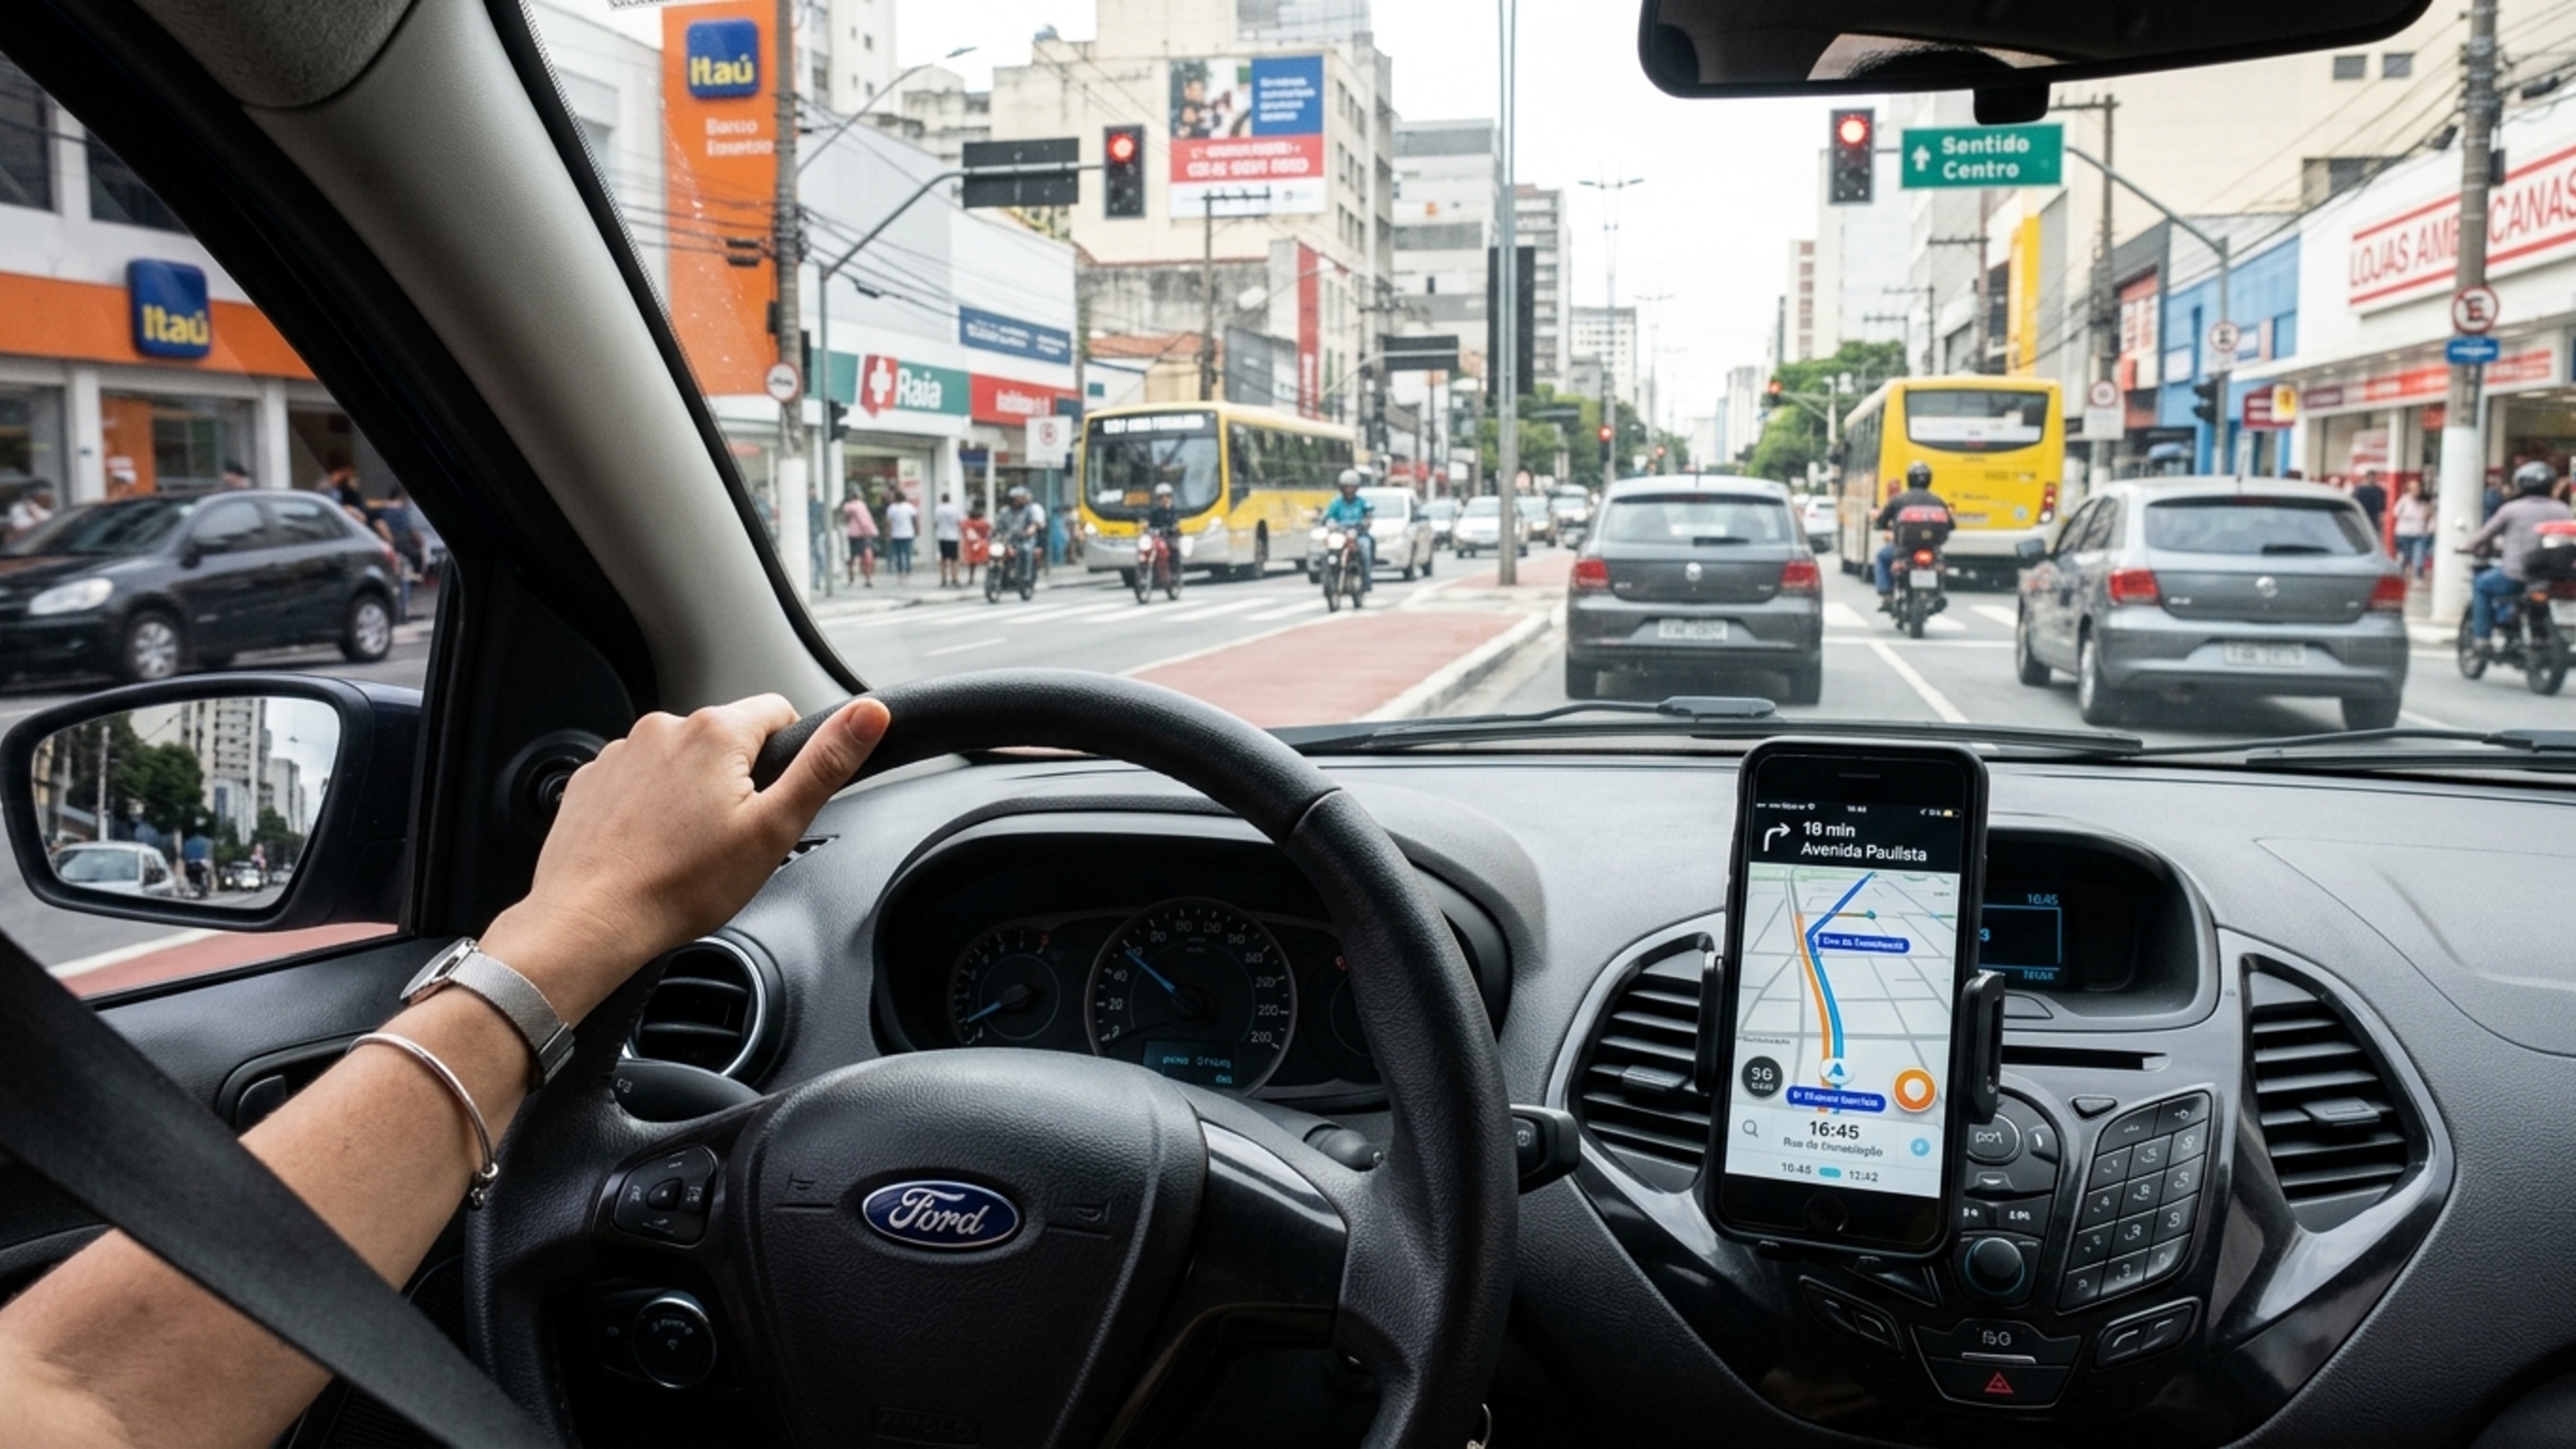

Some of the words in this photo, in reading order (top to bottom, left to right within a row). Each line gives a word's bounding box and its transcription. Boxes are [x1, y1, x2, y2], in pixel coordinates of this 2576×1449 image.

[691, 54, 754, 86] Itaú
[1942, 134, 2030, 155] Sentido
[1942, 161, 2020, 179] Centro
[2350, 232, 2409, 287] LOJAS
[2415, 167, 2576, 268] AMECANAS
[142, 303, 209, 345] Itaú
[897, 367, 942, 409] Raia
[1802, 821, 1822, 835] 18
[1826, 822, 1856, 837] min
[1801, 842, 1862, 859] Avenida
[1867, 844, 1928, 862] Paulista
[1108, 997, 1123, 1010] 20
[1809, 1120, 1860, 1140] 16:45
[888, 1188, 990, 1234] Ford
